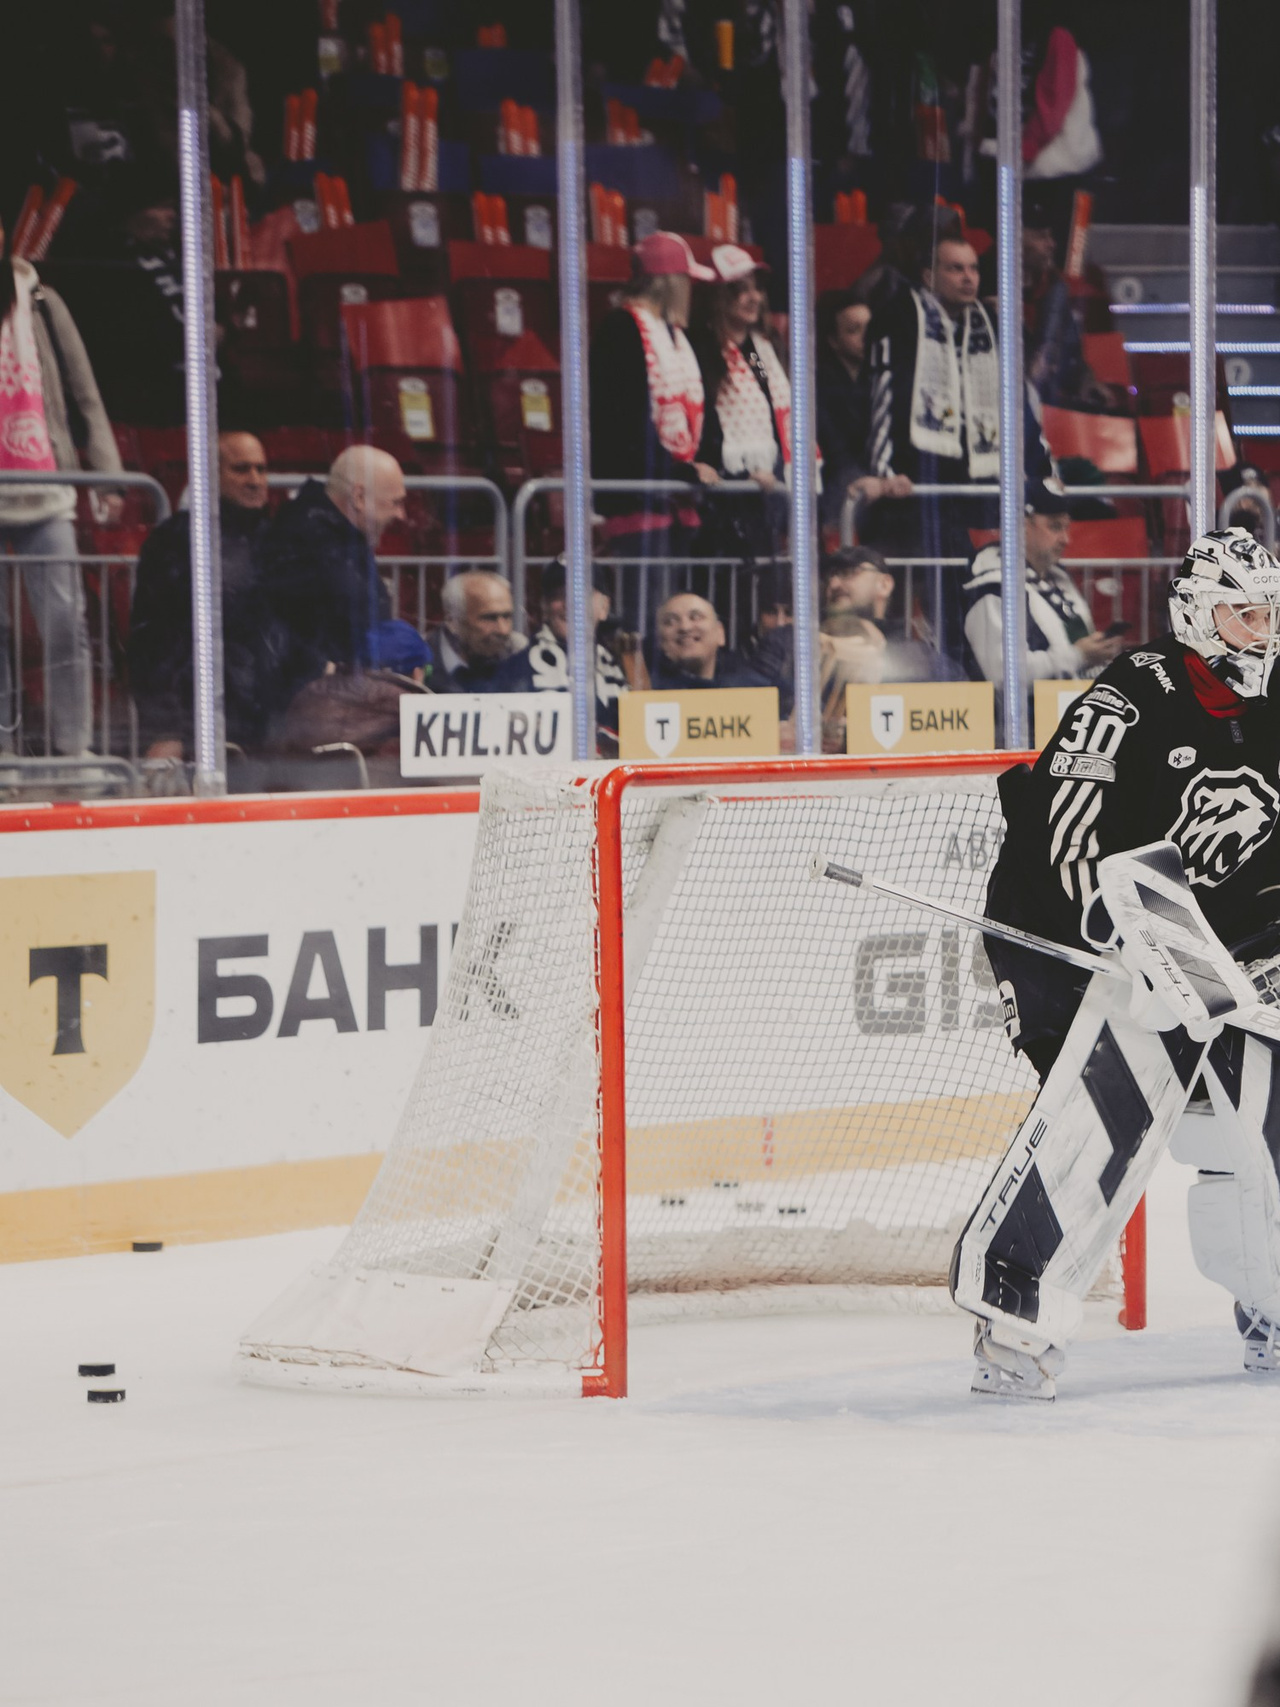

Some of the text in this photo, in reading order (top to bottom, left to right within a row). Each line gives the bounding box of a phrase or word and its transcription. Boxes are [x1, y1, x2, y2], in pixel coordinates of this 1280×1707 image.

[414, 710, 560, 758] KHL.RU
[687, 715, 752, 739] БАНК
[909, 708, 970, 732] БАНК
[1059, 705, 1127, 760] 30
[980, 1118, 1048, 1233] TRUE
